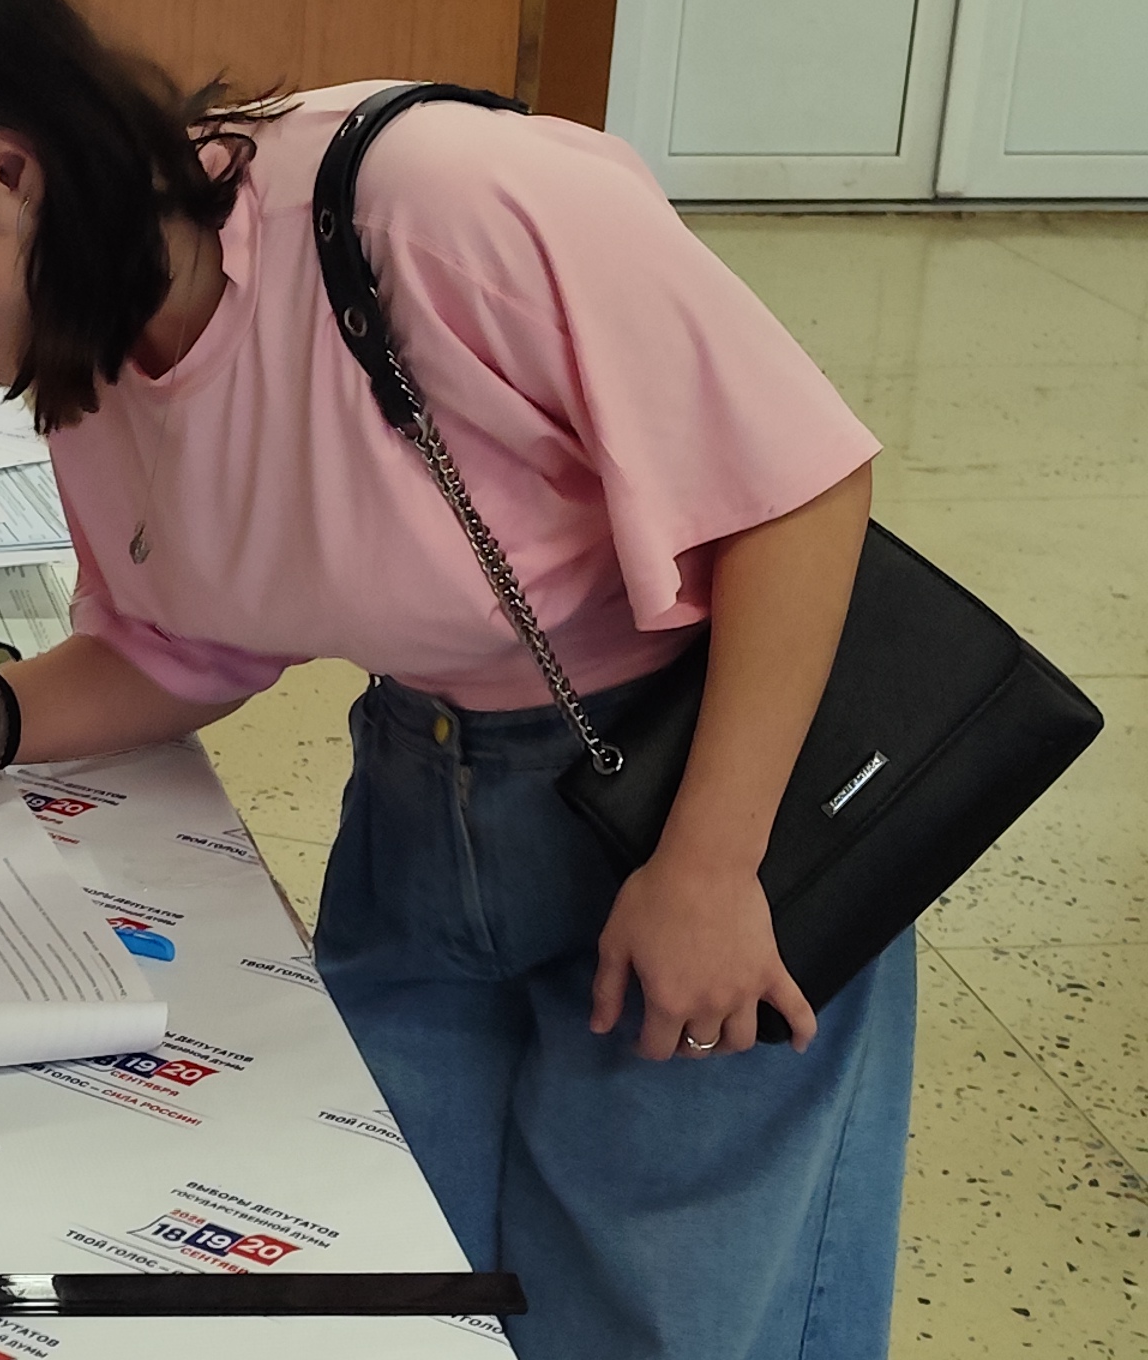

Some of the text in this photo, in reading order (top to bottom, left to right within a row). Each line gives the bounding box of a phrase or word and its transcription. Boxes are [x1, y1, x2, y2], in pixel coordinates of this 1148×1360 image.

[50, 799, 84, 814] 20
[124, 1056, 156, 1073] 19
[161, 1063, 203, 1081] 20
[44, 1068, 90, 1088] ГОЛОС
[101, 1088, 139, 1106] СИЛА
[318, 1110, 358, 1127] ТВОЙ
[169, 1208, 206, 1226] 2026
[170, 1188, 332, 1250] ГОСУДАРСТВЕННОЙ ДУМЫ
[186, 1181, 340, 1240] ВЫБОРЫ ДЕПУТАТОВ
[65, 1228, 109, 1249] ТВОЙ
[106, 1244, 159, 1269] ГОЛОС
[151, 1222, 284, 1261] 18 19 20
[180, 1246, 250, 1275] СЕНТЯБР
[4, 1339, 49, 1359] ДУМЫ
